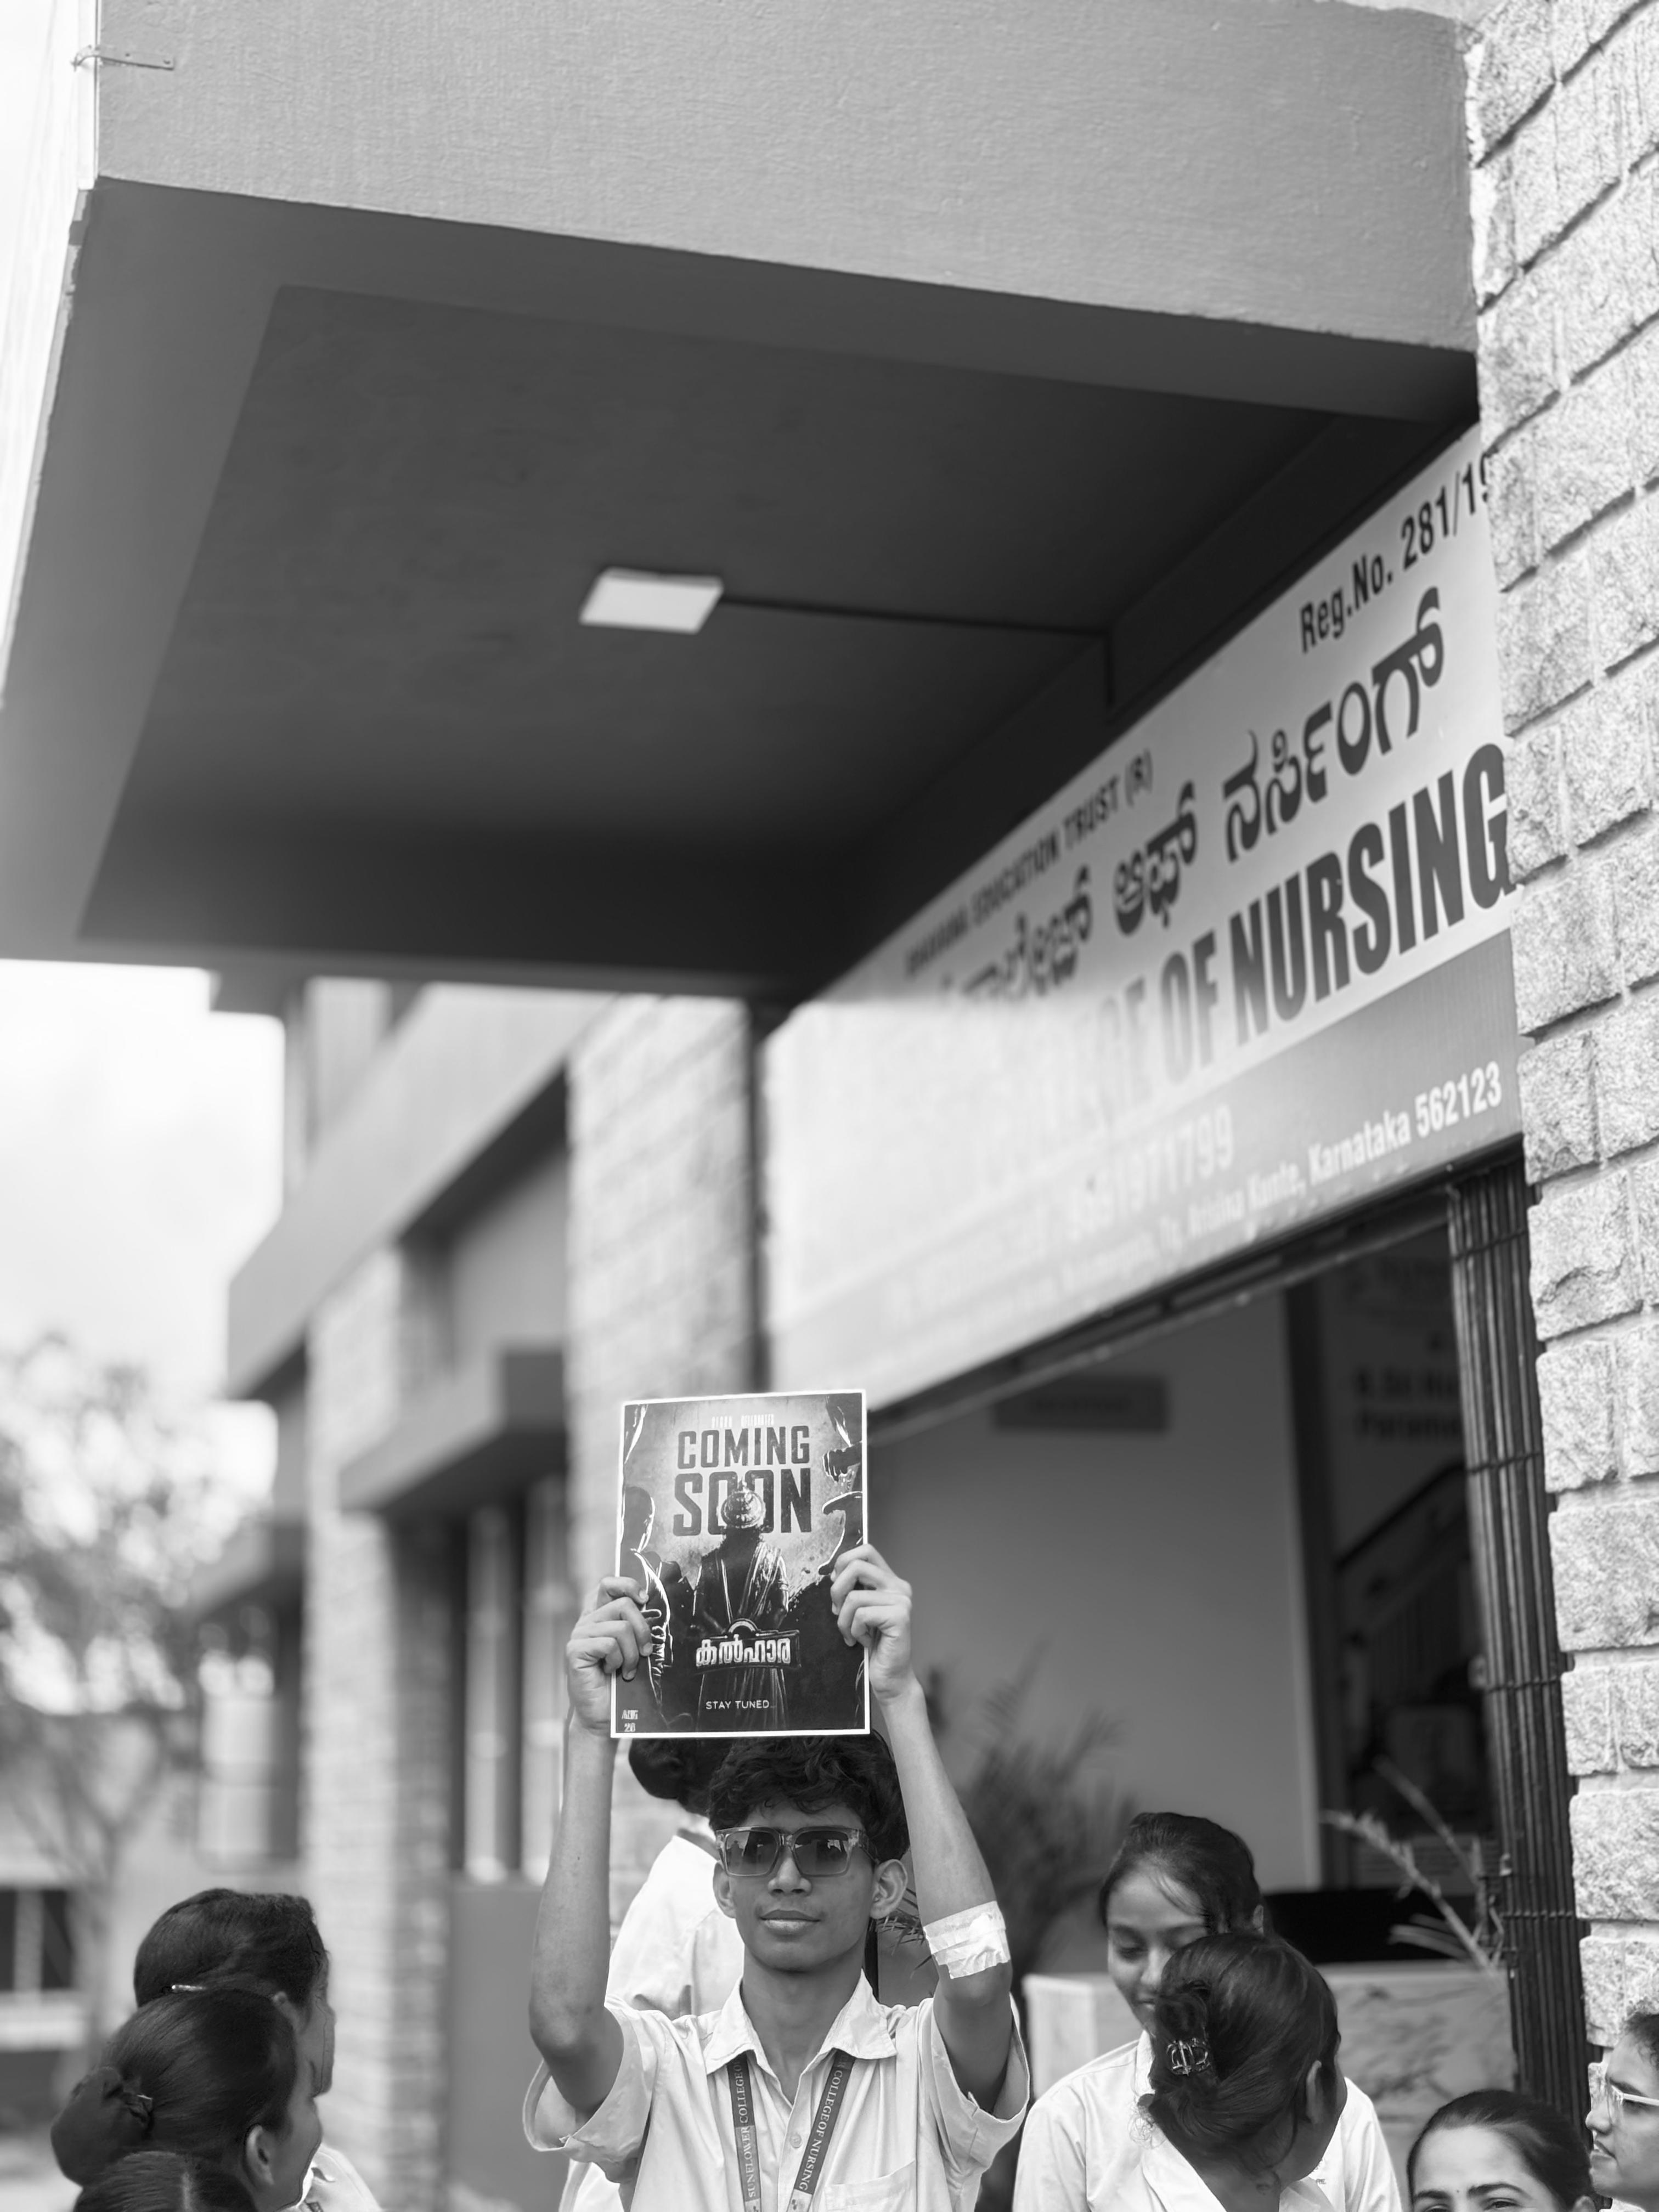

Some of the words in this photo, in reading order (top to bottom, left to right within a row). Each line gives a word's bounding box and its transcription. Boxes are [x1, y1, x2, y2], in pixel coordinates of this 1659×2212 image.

[1300, 554, 1393, 653] Reg.No.
[1160, 926, 1217, 1084] OF
[1229, 744, 1516, 1046] NURSING
[1308, 1108, 1412, 1186] Karnataka
[1414, 1061, 1502, 1138] 562123
[678, 1425, 810, 1470] COMING
[673, 1468, 812, 1537] SOON
[706, 1700, 731, 1709] STAY
[735, 1700, 770, 1709] TUNED
[735, 2073, 749, 2124] COLLEGE
[820, 2069, 843, 2121] COLLEGE
[816, 2121, 827, 2138] OF
[741, 2125, 757, 2198] SUNFLOWER
[799, 2138, 822, 2191] NURSING
